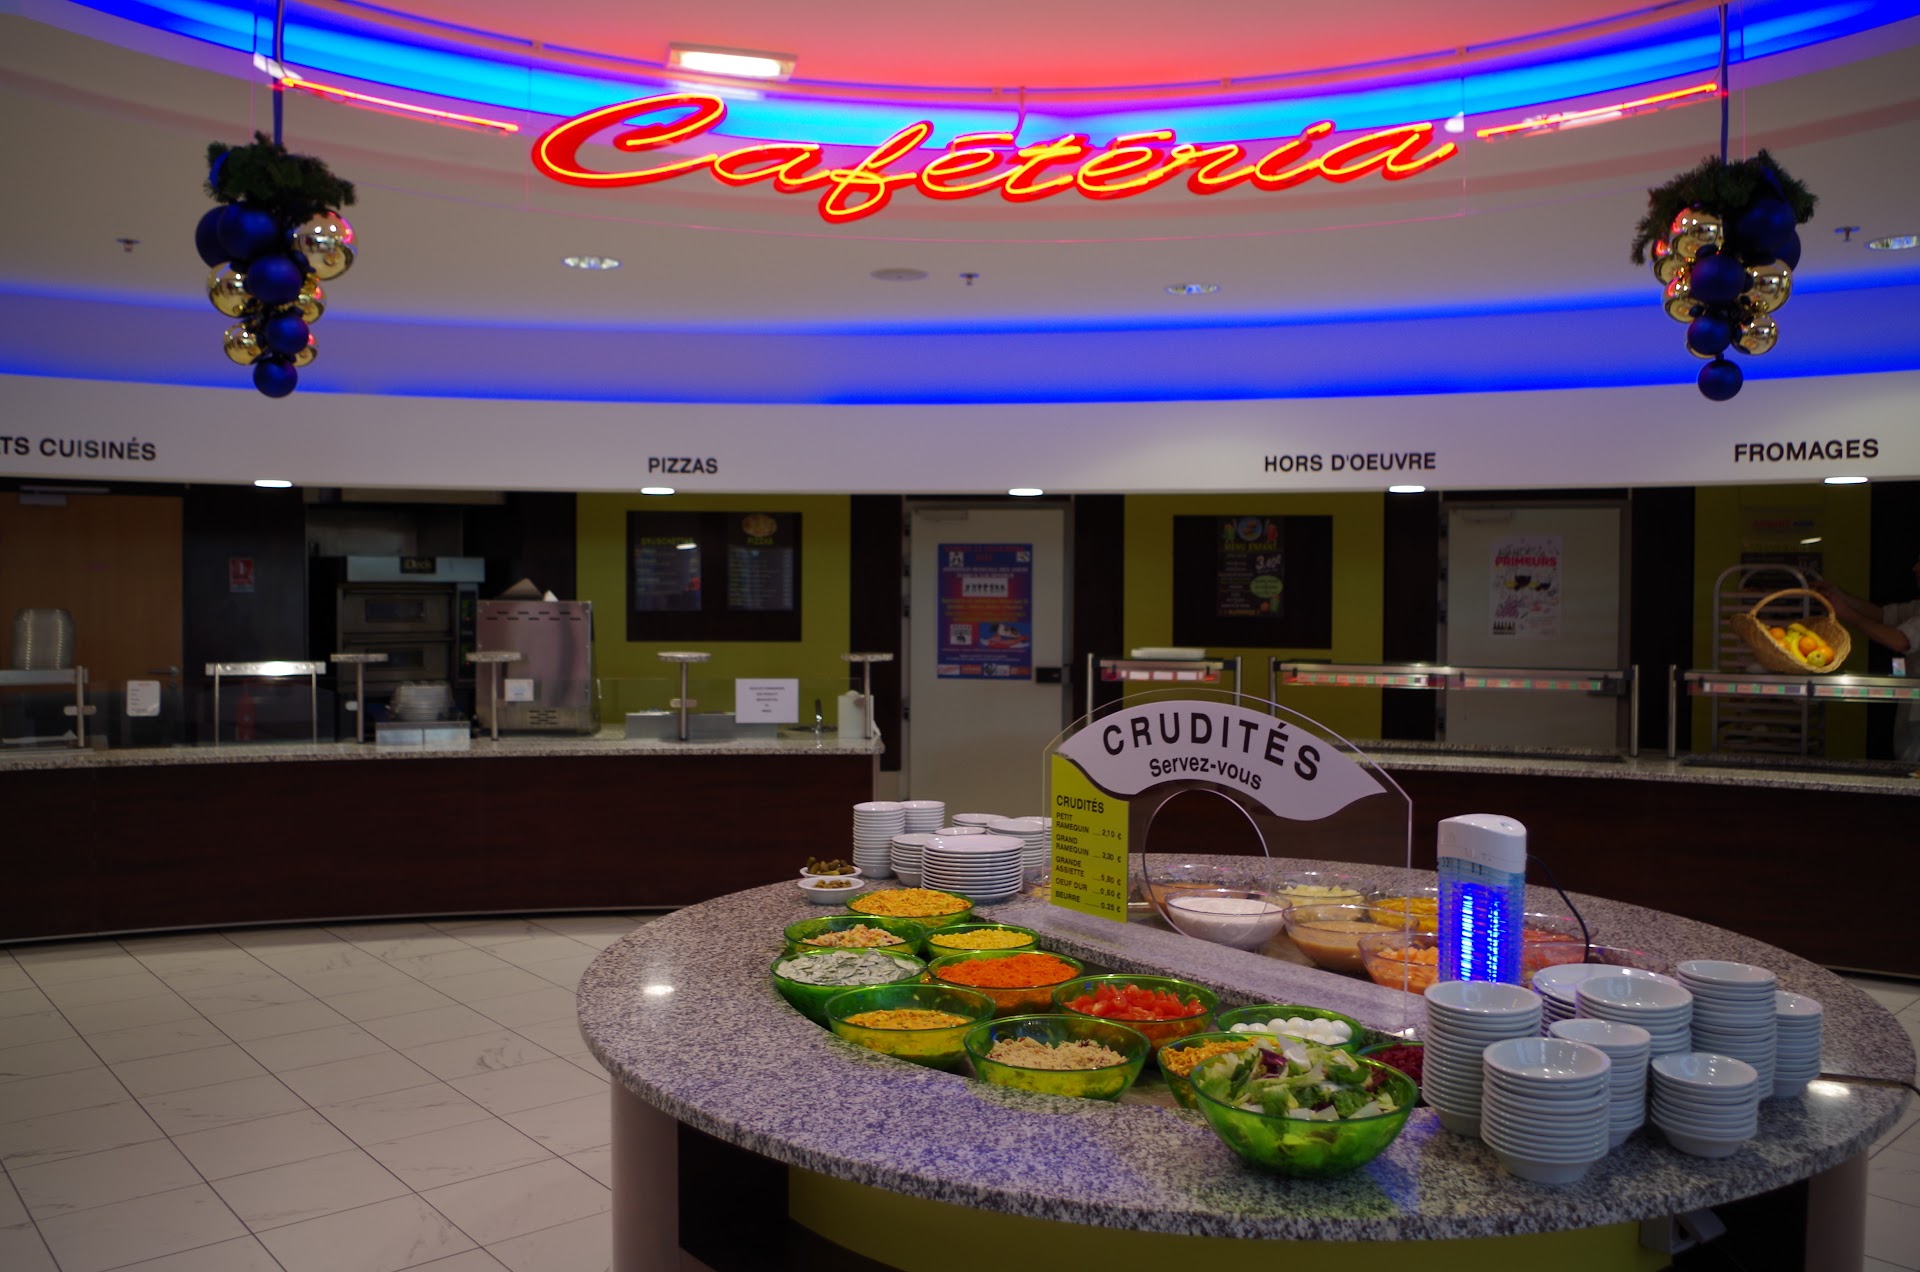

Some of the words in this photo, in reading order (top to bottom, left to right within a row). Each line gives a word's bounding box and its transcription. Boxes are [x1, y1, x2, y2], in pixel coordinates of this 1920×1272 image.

[531, 93, 1457, 223] Cafétéria
[39, 437, 157, 461] CUISINÉS
[1734, 438, 1879, 463] FROMAGES
[648, 457, 718, 475] PIZZAS
[1264, 454, 1323, 473] HORS
[1331, 452, 1436, 471] D'OEUVRE
[1103, 712, 1321, 781] CRUDITÉS
[1149, 756, 1262, 790] Servez-vous
[1056, 795, 1104, 814] CRUDITÉS
[1056, 812, 1072, 821] PETIT
[1056, 821, 1089, 833] RAMEQUIN
[1056, 834, 1078, 844] GRAND
[1056, 843, 1089, 856] RAMEQUIN
[1056, 856, 1082, 867] GRANDE
[1056, 865, 1084, 877] ASSIETTE
[1056, 877, 1072, 887] OEUF
[1074, 881, 1088, 891] DUR
[1056, 890, 1080, 902] BEURRE
